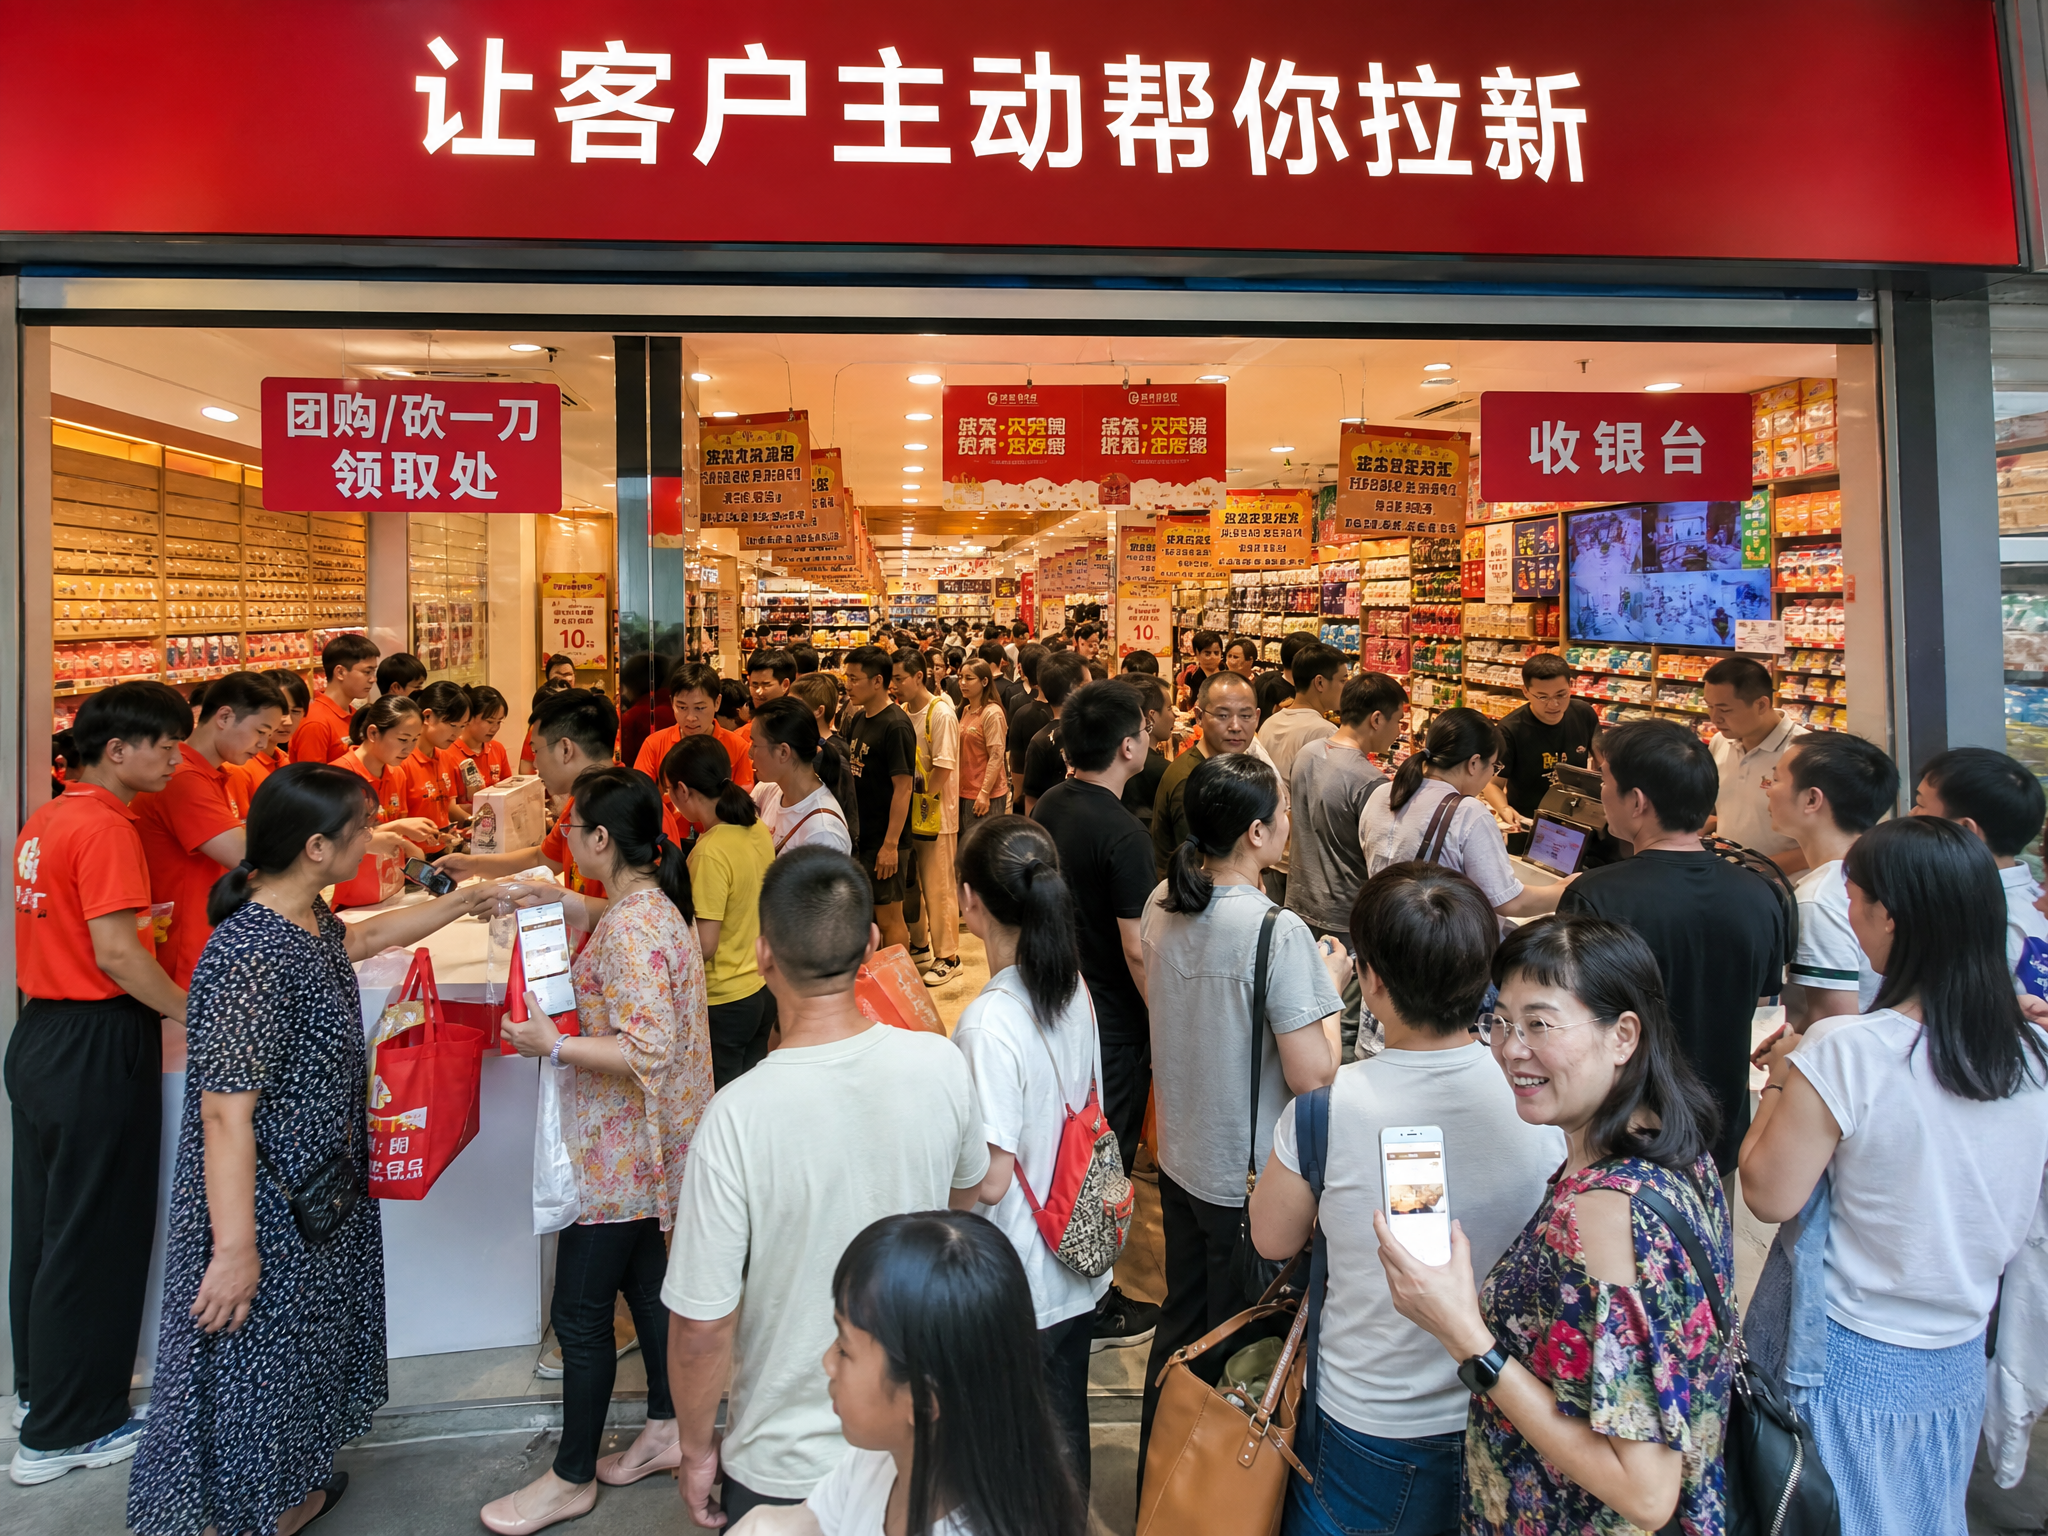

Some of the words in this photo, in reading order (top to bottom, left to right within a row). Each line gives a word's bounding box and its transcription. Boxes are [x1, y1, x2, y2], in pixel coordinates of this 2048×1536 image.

[415, 36, 1588, 183] 让客户主动帮你拉新
[286, 391, 539, 444] 团购/砍一刀
[1528, 420, 1706, 475] 收银台
[331, 448, 498, 501] 领取处
[560, 629, 585, 649] 10
[1133, 624, 1154, 641] 10
